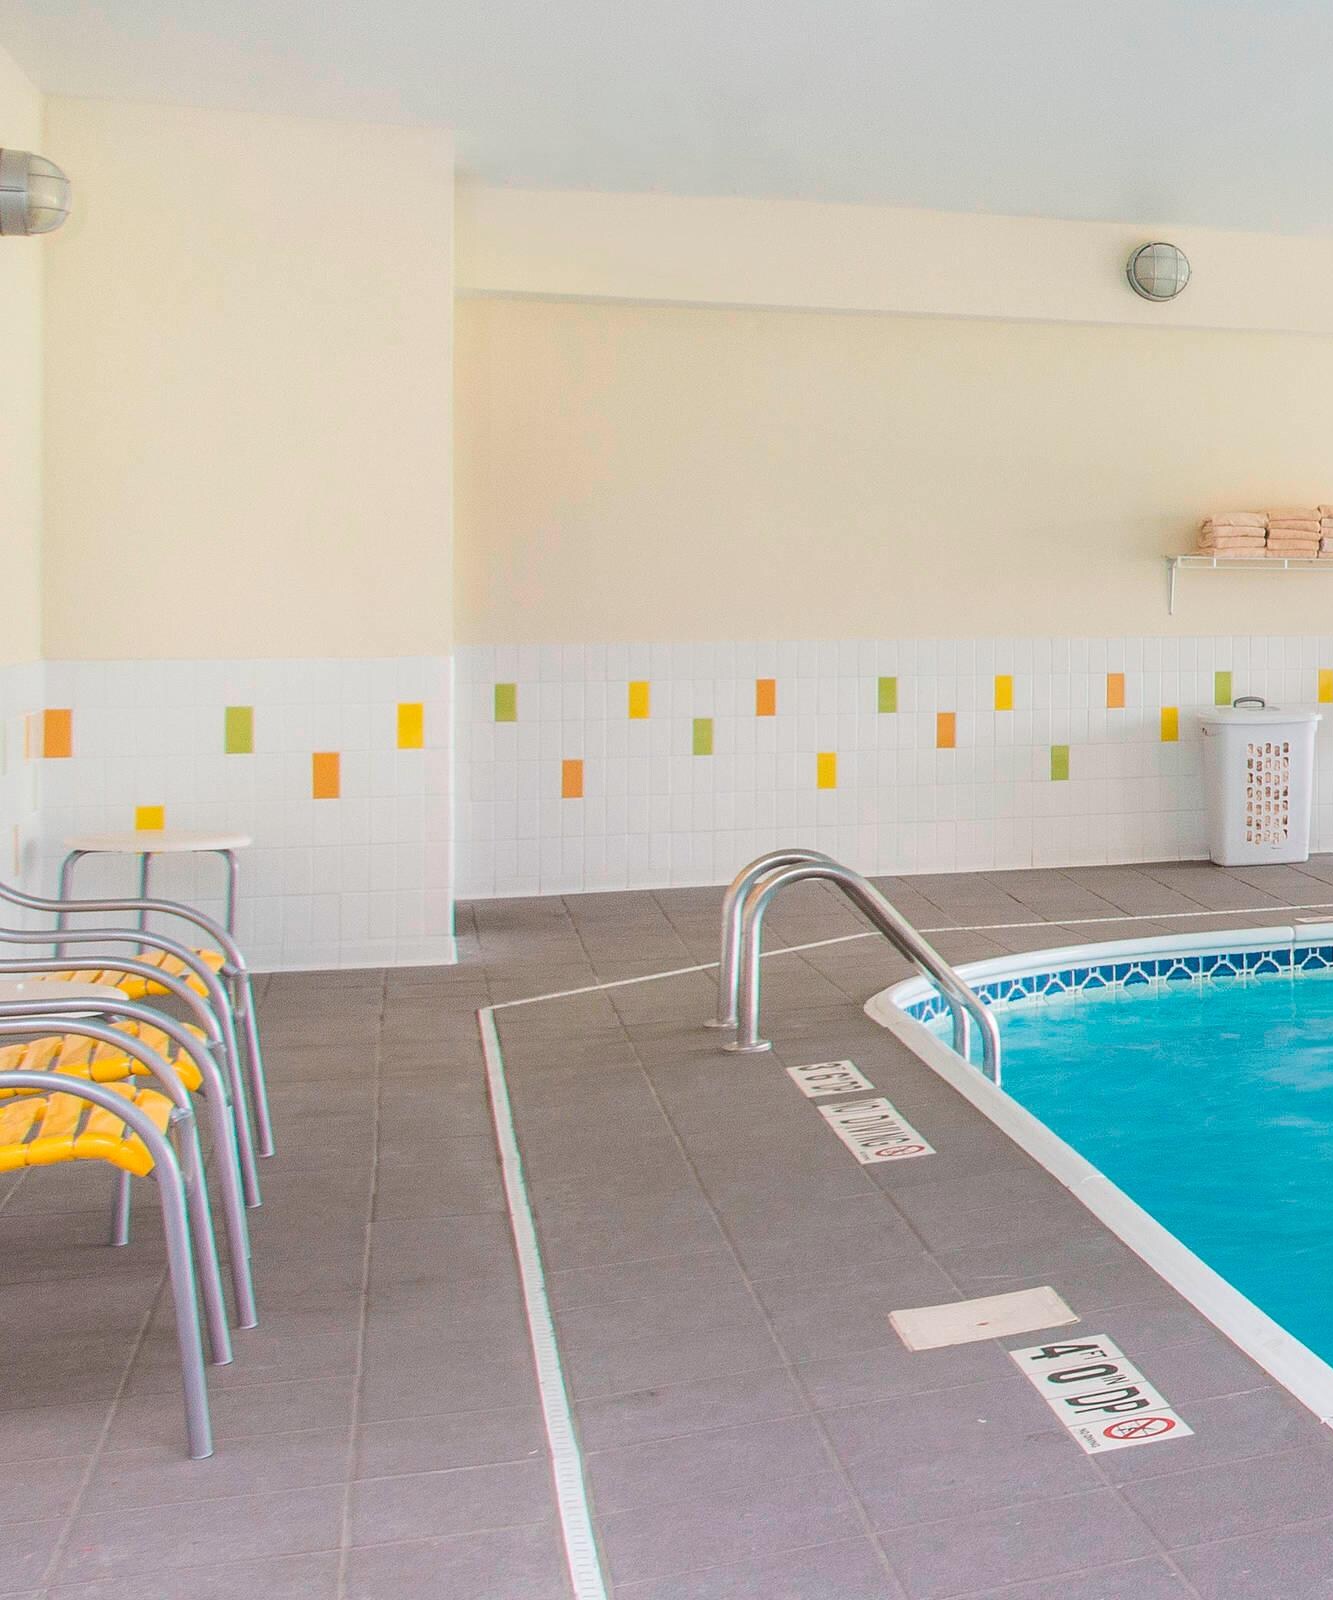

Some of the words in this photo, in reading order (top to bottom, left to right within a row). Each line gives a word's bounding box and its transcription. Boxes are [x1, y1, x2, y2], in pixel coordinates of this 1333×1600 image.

[839, 1114, 911, 1147] DIVING
[1030, 1344, 1100, 1360] 4
[1080, 1350, 1107, 1360] FT
[1047, 1364, 1119, 1383] 0
[1103, 1374, 1130, 1386] IN
[1064, 1386, 1150, 1414] DP
